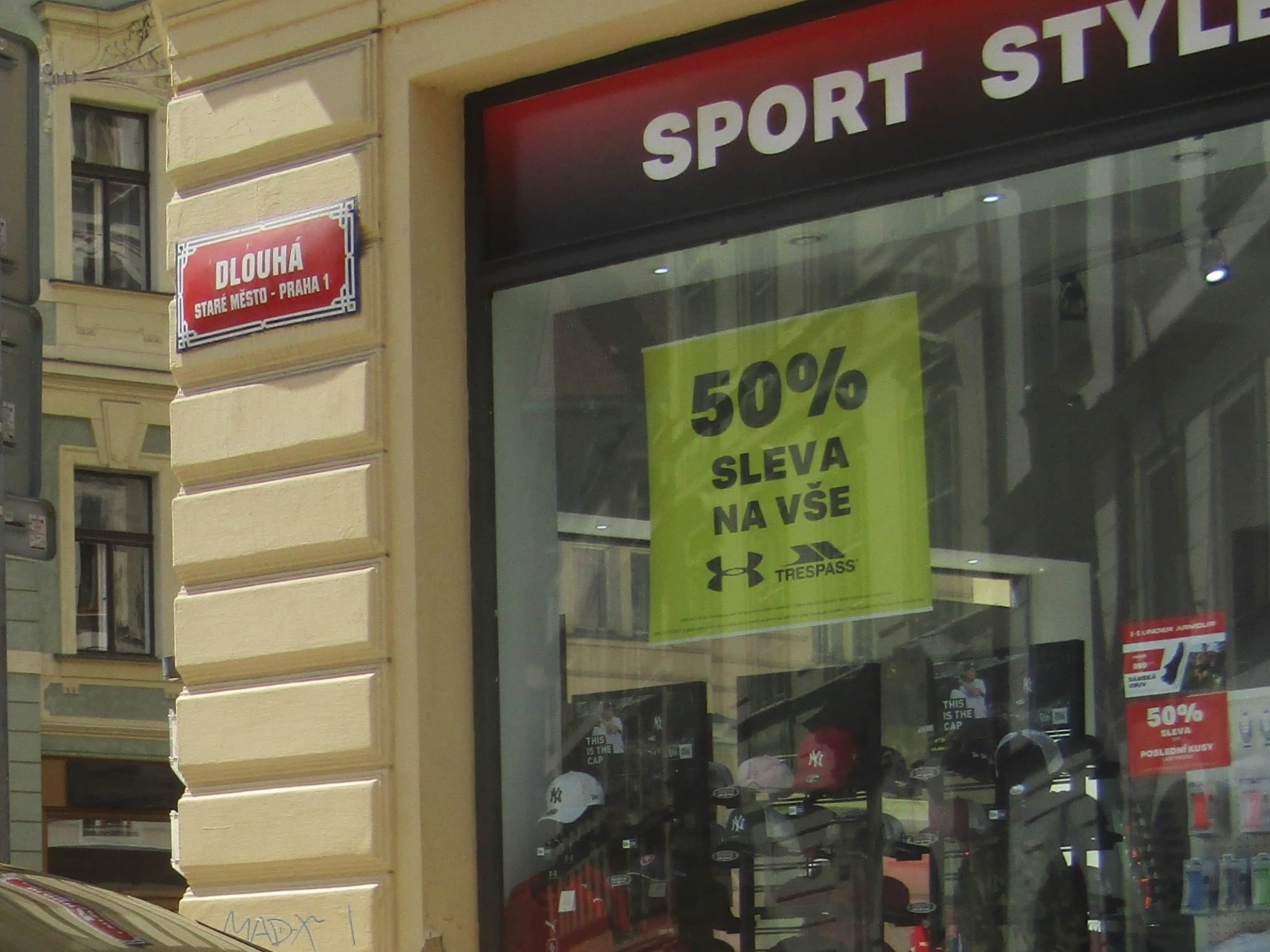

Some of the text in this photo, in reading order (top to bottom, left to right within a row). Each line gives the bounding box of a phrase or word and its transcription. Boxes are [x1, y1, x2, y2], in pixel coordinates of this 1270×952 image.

[642, 51, 923, 181] SPORT
[215, 235, 304, 290] DLOUHÁ
[194, 292, 228, 319] STARÉ
[230, 287, 268, 311] MĚSTO
[279, 275, 320, 300] PRAHA
[323, 273, 330, 291] 1
[690, 345, 868, 437] 50%
[711, 436, 850, 489] SLEVA
[713, 481, 852, 536] NA VŠE
[775, 559, 856, 582] TRESPASS
[1141, 621, 1216, 636] UNDER ARMOUR
[943, 699, 964, 709] THIS
[943, 709, 973, 720] IS THE
[1147, 703, 1204, 728] 50%
[944, 721, 962, 731] CAP
[1160, 727, 1192, 737] SLEVA
[586, 736, 606, 744] THIS
[587, 746, 612, 755] IS THE
[1140, 743, 1214, 758] POSLEDNÍ KUSY
[587, 756, 603, 765] CAP
